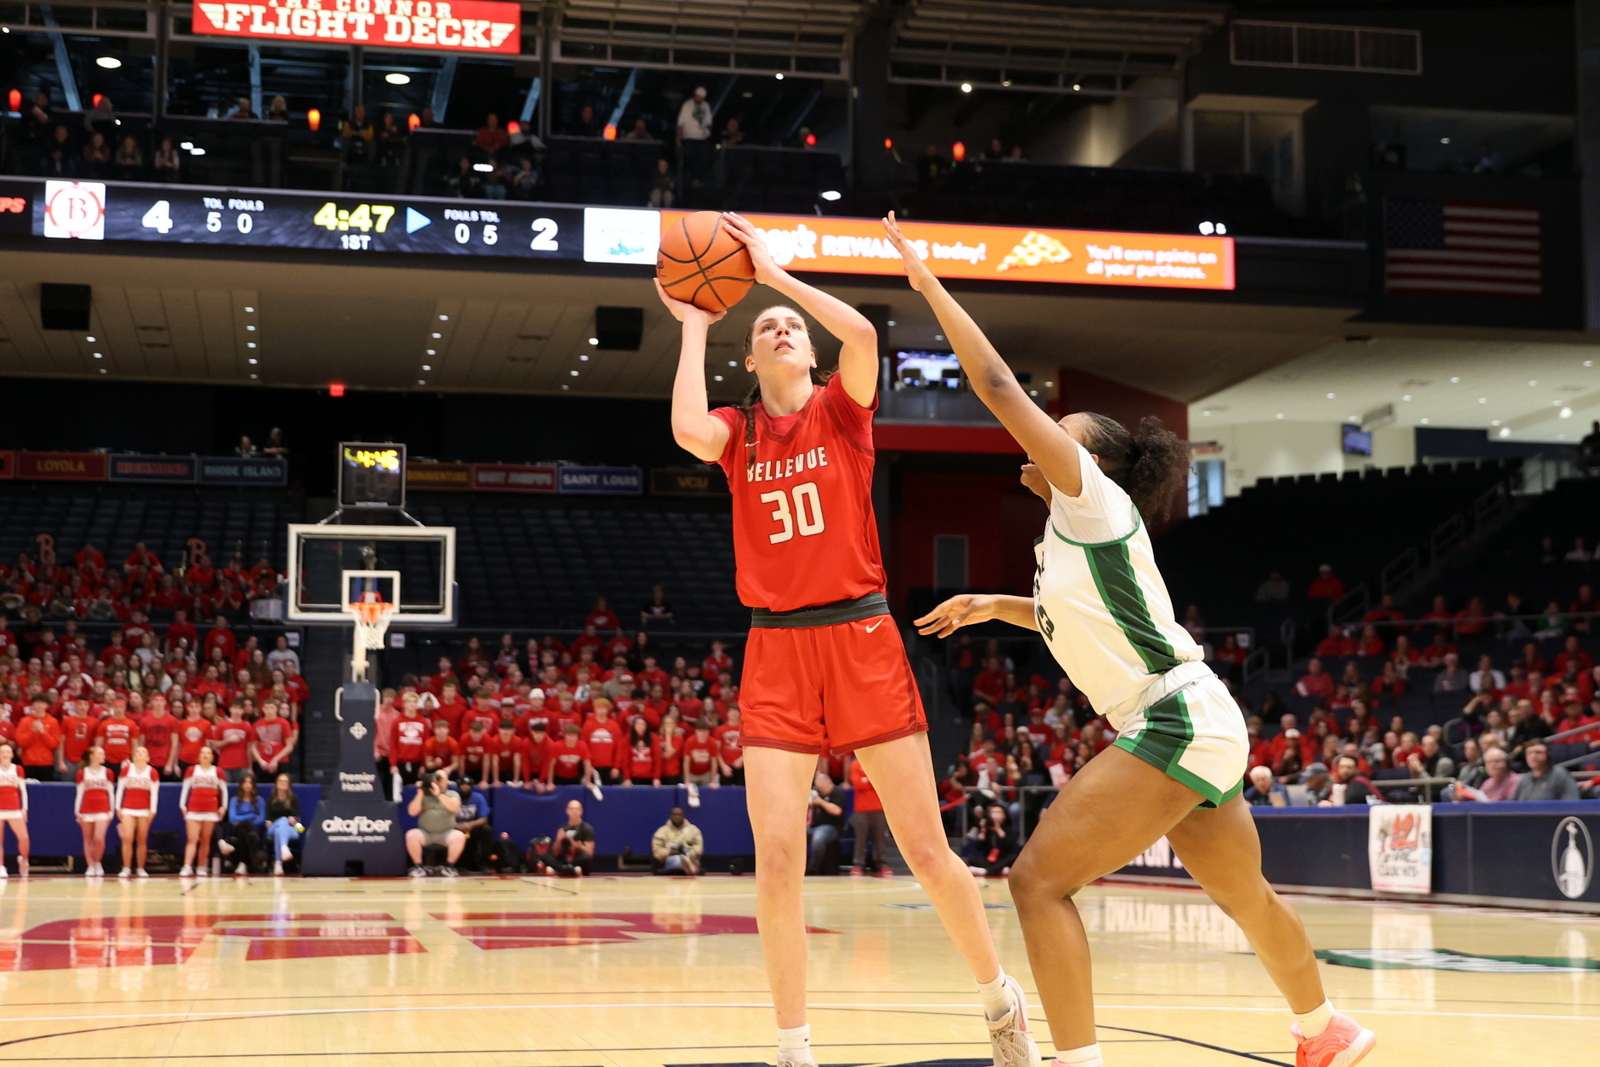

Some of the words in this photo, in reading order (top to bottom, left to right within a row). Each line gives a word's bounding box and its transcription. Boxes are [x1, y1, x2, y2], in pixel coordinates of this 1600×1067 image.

[335, 0, 453, 19] CONNOR
[224, 2, 375, 40] FLIGHT
[384, 14, 491, 48] DECK
[203, 197, 225, 210] TOL
[228, 198, 265, 212] FOULS
[444, 209, 479, 222] FOULS
[479, 211, 500, 223] TOL
[142, 200, 173, 234] 4
[206, 211, 222, 233] 5
[237, 213, 253, 234] 0
[313, 202, 395, 233] 4:47
[340, 235, 372, 250] 1ST
[454, 223, 470, 244] 0
[483, 225, 498, 245] 5
[530, 218, 559, 251] 2
[931, 241, 987, 265] today!
[37, 460, 85, 473] LOYOLA
[746, 446, 829, 483] BELLEVUE
[562, 473, 599, 486] SAINT
[602, 474, 639, 488] LOUIS
[760, 482, 825, 545] 30
